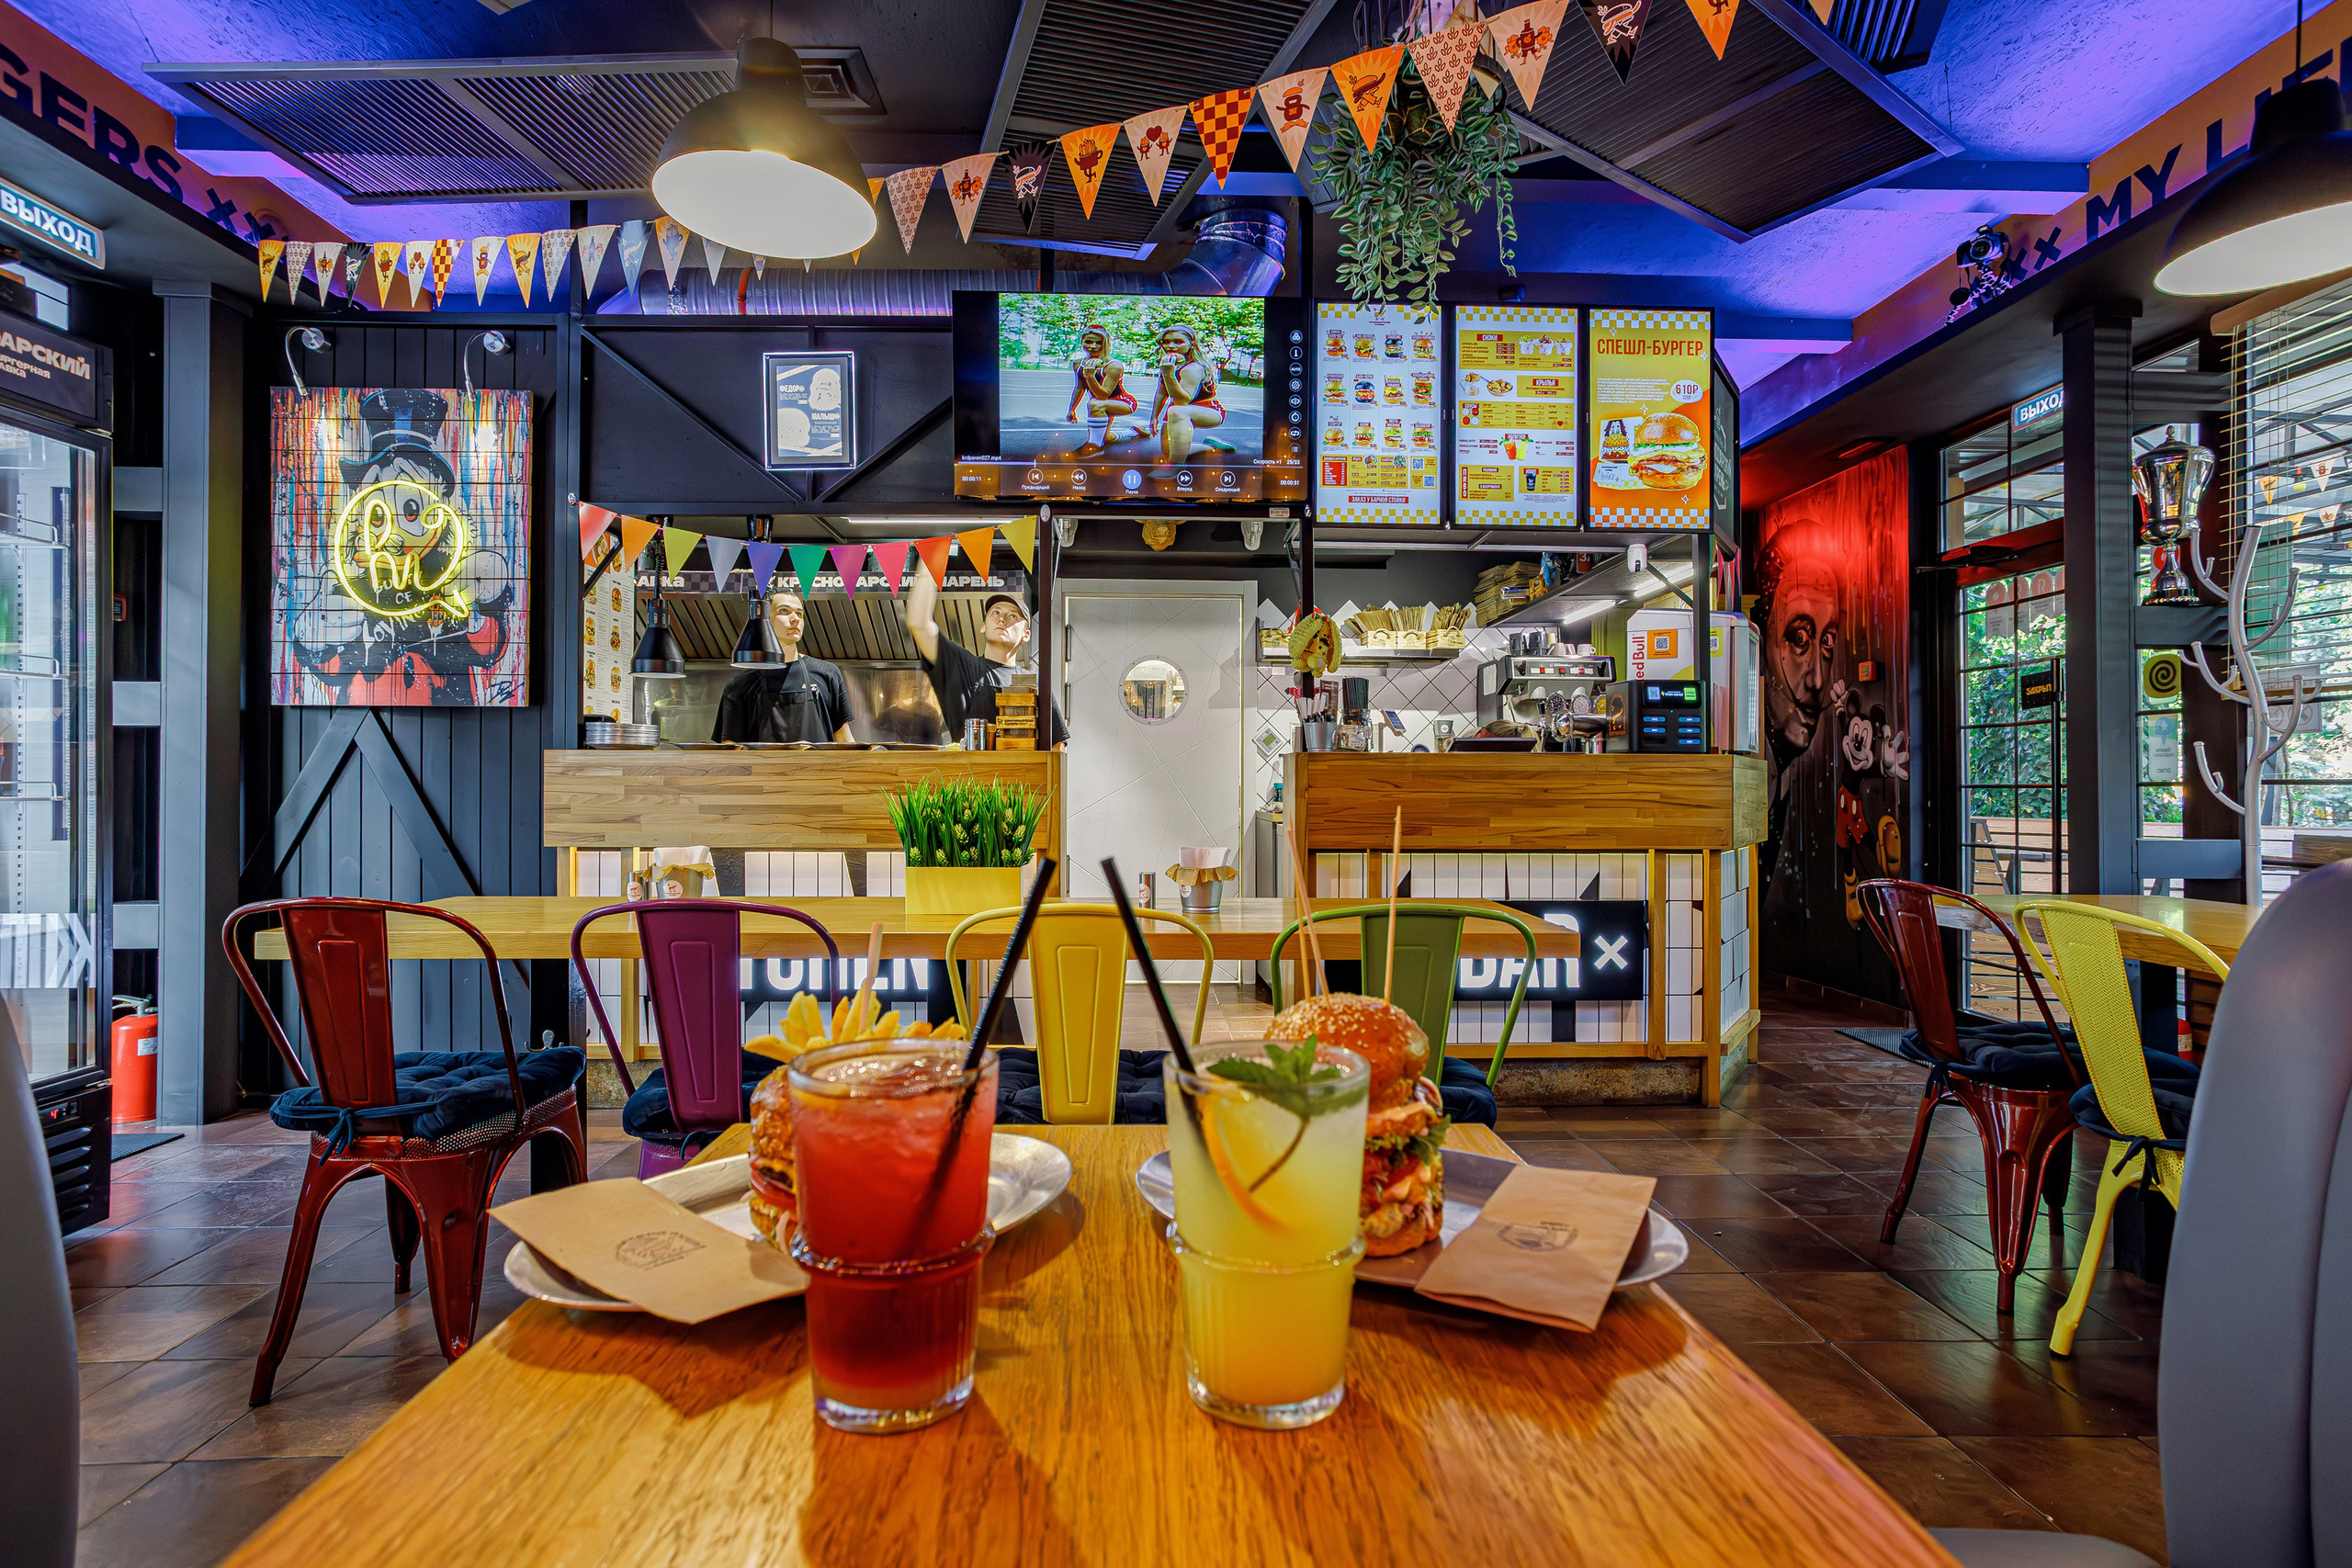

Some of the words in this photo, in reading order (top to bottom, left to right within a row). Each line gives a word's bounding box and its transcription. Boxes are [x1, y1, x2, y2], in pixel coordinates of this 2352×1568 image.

[2086, 143, 2183, 243] MY
[1, 187, 93, 257] ВЫХОД
[0, 332, 90, 380] АРСКИЙ
[1597, 338, 1703, 356] СПЕШЛ-БУРГЕР
[777, 576, 918, 587] КРСНОАРСИ
[1632, 636, 1645, 660] Bull
[1632, 662, 1645, 681] ed
